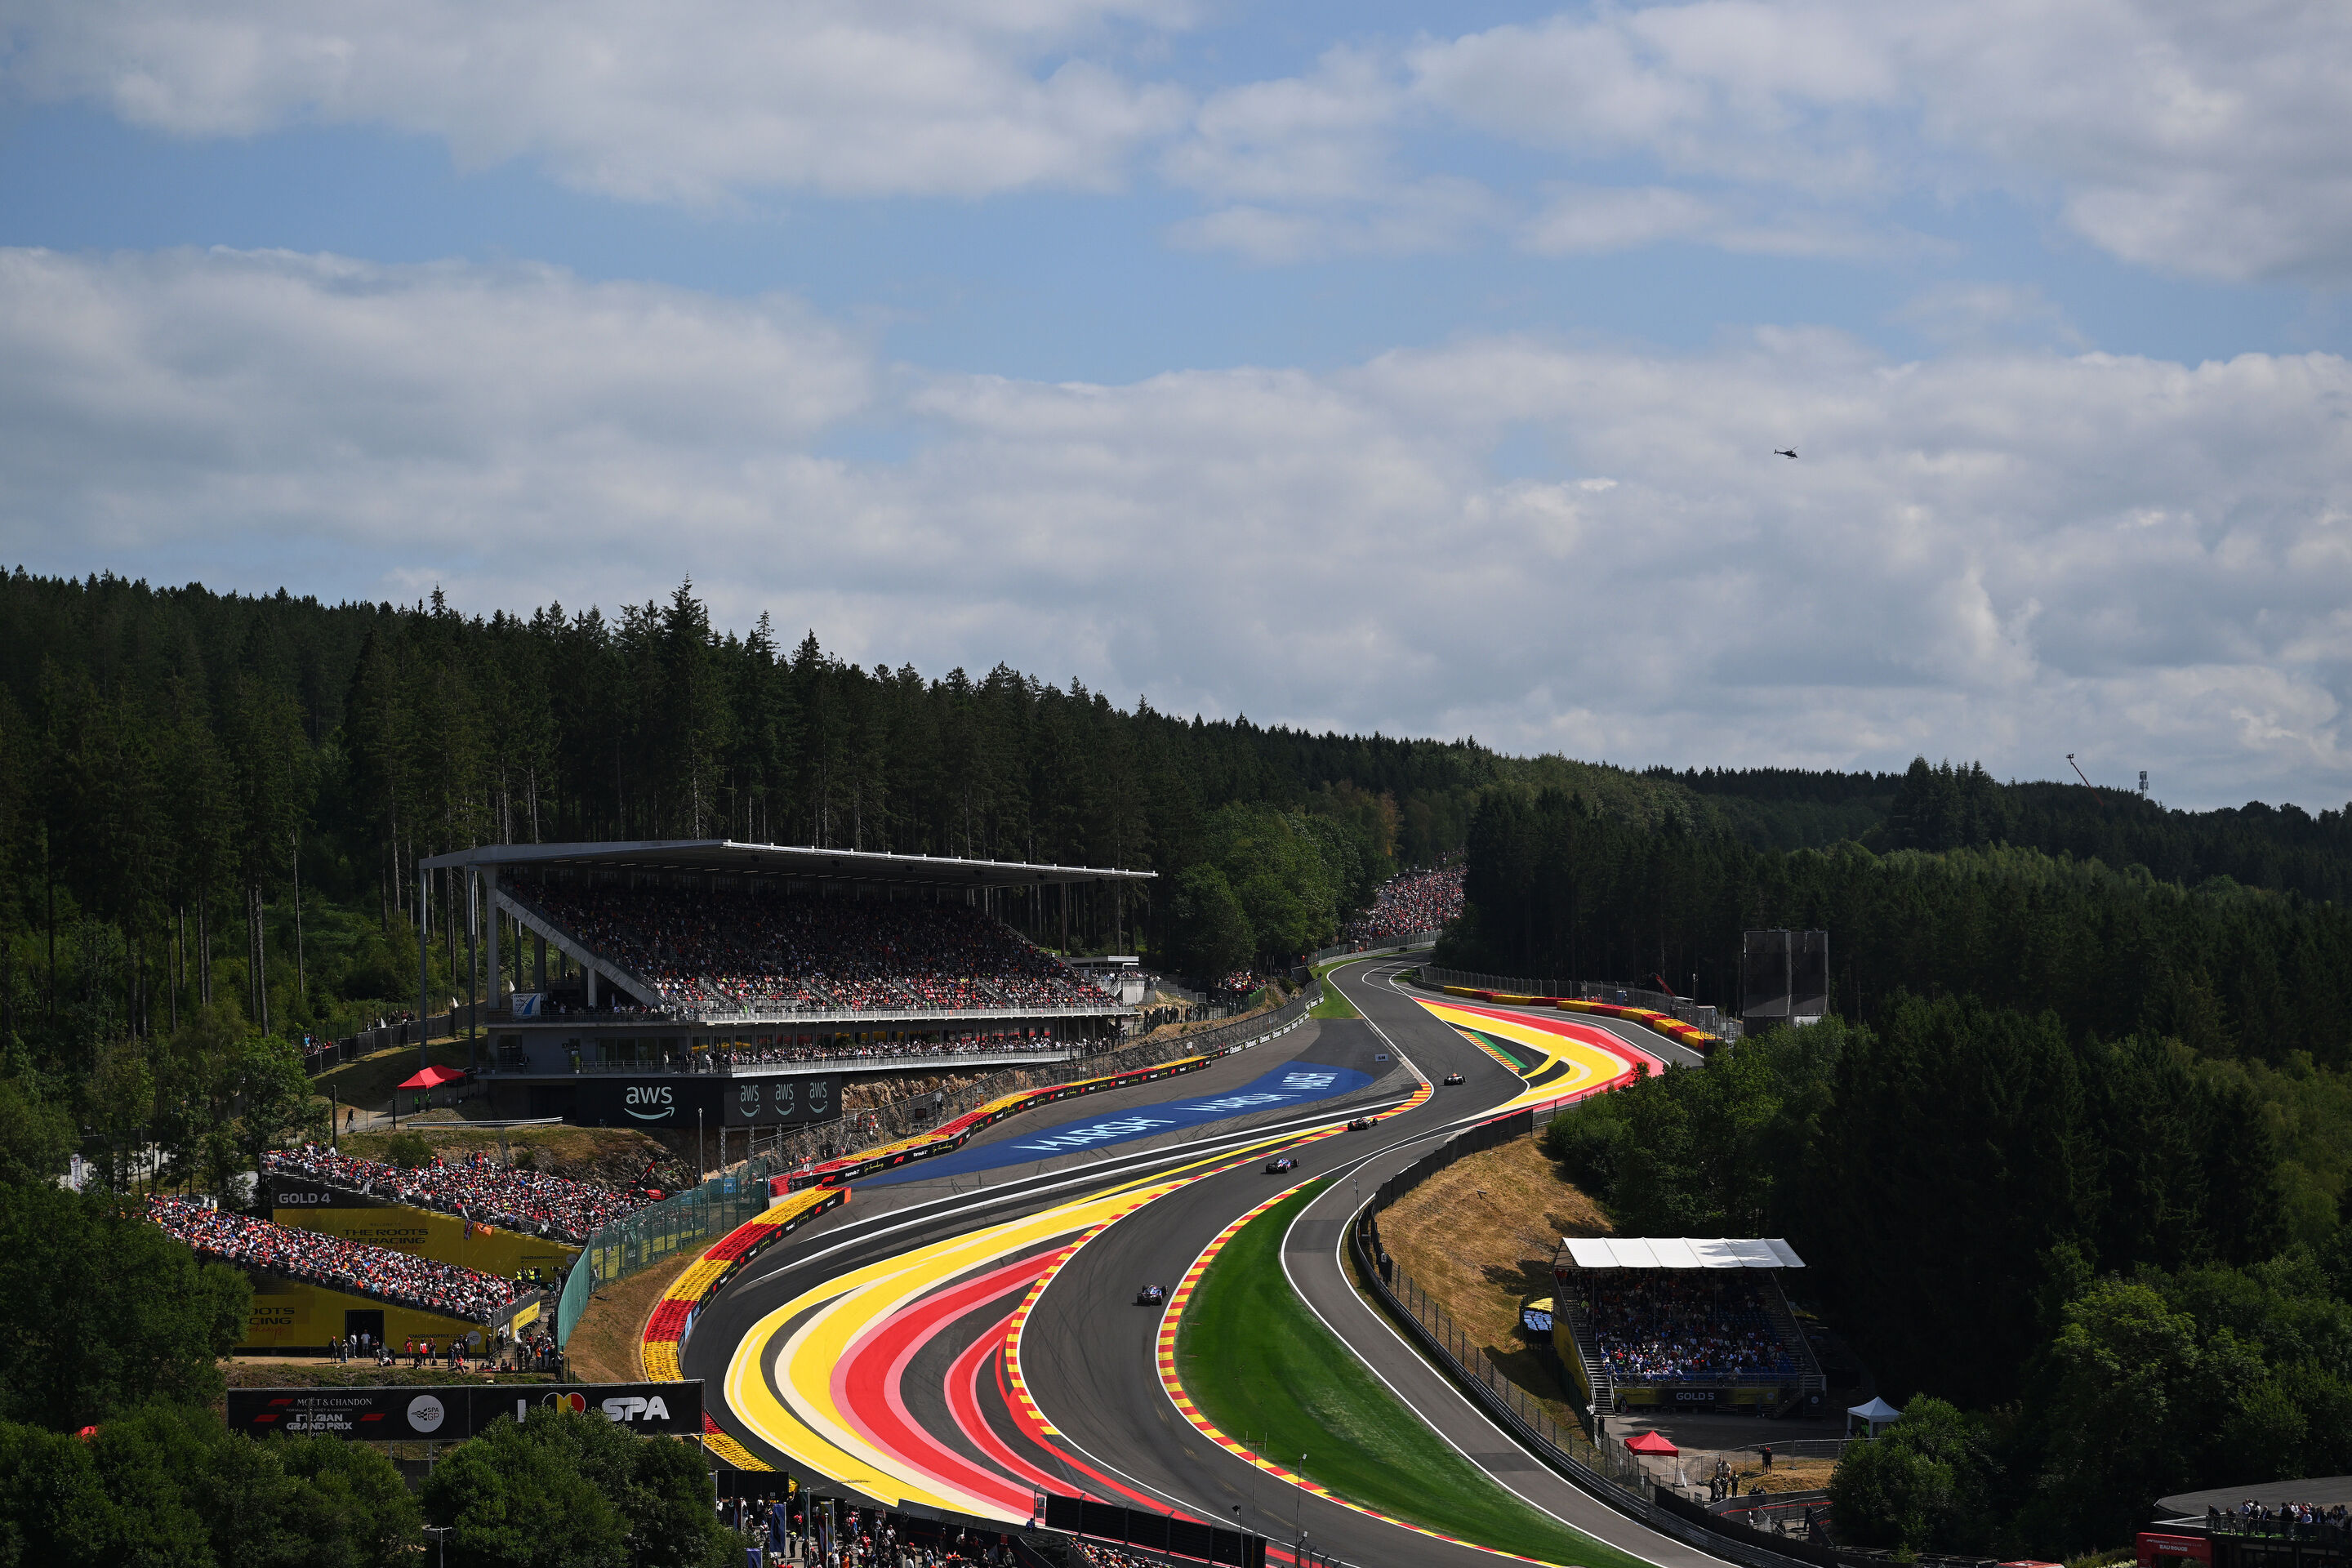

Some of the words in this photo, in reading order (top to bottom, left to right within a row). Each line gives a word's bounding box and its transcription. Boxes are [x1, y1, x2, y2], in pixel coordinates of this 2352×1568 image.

[1229, 1045, 1242, 1054] Globant
[1245, 1039, 1257, 1049] Globant
[626, 1086, 673, 1104] aws
[740, 1084, 760, 1102] aws
[776, 1083, 794, 1101] aws
[809, 1081, 827, 1099] aws
[1009, 1116, 1177, 1152] MARSH
[278, 1192, 318, 1204] GOLD
[320, 1192, 332, 1204] 4
[330, 1397, 372, 1406] CHANDON
[1676, 1392, 1706, 1401] GOLD
[1707, 1392, 1715, 1401] 5
[602, 1396, 670, 1422] SPA
[427, 1413, 440, 1421] GP
[286, 1422, 326, 1430] GRAND
[327, 1422, 353, 1430] PRIX
